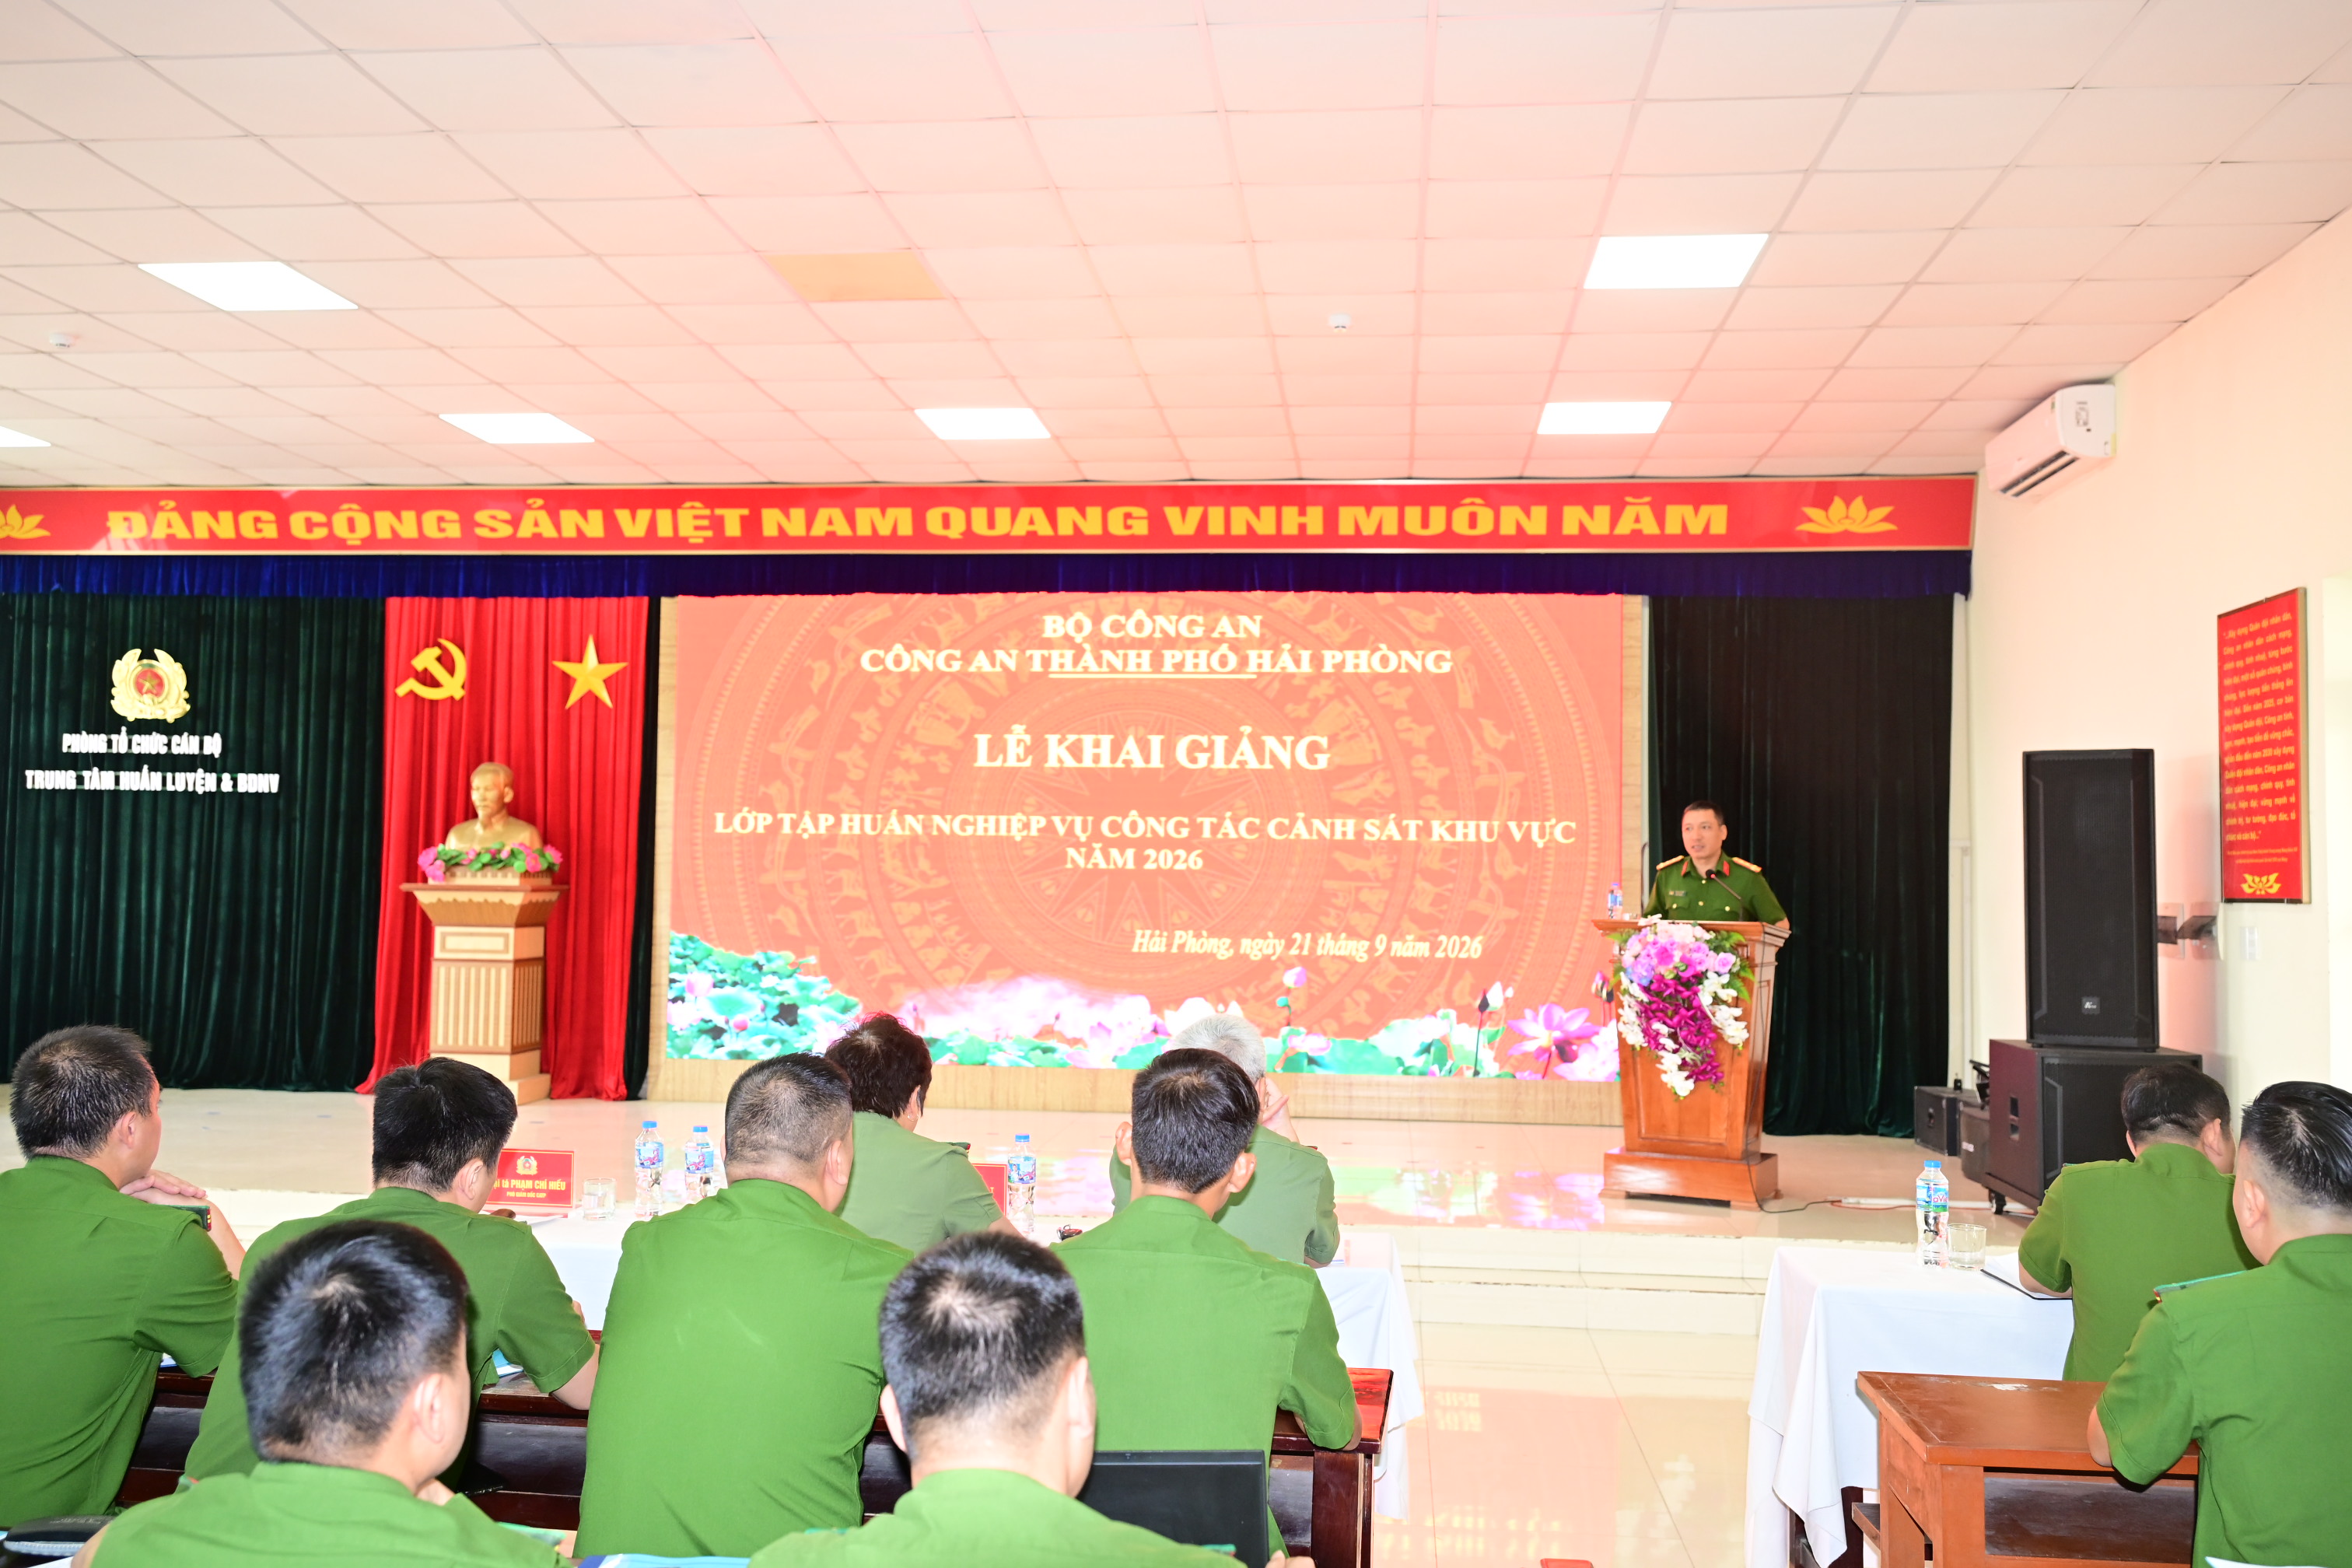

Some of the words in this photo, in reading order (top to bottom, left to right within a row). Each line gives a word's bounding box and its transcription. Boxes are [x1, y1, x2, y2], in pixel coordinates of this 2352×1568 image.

[107, 500, 278, 539] ĐẢNG
[290, 503, 461, 545] CỘNG
[474, 498, 604, 538] SẢN
[614, 501, 749, 543] VIỆT
[761, 507, 913, 537] NAM
[926, 506, 1149, 539] QUANG
[1164, 506, 1323, 536] VINH
[1338, 497, 1548, 536] MUÔN
[1562, 495, 1728, 536] NĂM
[1041, 611, 1093, 643] BỘ
[1101, 608, 1206, 639] CÔNG
[1211, 614, 1263, 638] AN
[2266, 633, 2277, 642] cách
[859, 643, 963, 672] CÔNG
[968, 649, 1020, 672] AN
[1025, 642, 1153, 672] THÀNH
[1160, 643, 1237, 673] PHỐ
[1245, 643, 1313, 673] HẢI
[1321, 643, 1454, 674] PHÒNG
[2264, 716, 2277, 725] Công
[2284, 711, 2294, 720] tinh,
[62, 730, 107, 754] PHÒNG
[111, 726, 129, 754] TỔ
[131, 731, 168, 755] CHỨC
[171, 731, 200, 754] CÁN
[203, 732, 222, 758] BỘ
[973, 724, 1033, 767] LỄ
[1044, 733, 1165, 768] KHAI
[1175, 725, 1331, 771] GIẢNG
[2282, 746, 2294, 754] dựng
[25, 769, 76, 789] TRUNG
[82, 767, 115, 790] TÂM
[119, 764, 163, 791] HUẤN
[166, 768, 217, 795] LUYỆN
[220, 772, 233, 793] &
[237, 773, 280, 793] BDNV
[2264, 765, 2277, 774] Công
[2283, 761, 2295, 770] nhân
[2286, 778, 2295, 786] tinh
[714, 807, 773, 834] LỚP
[777, 810, 835, 839] TẬP
[840, 809, 924, 835] HUẤN
[931, 812, 1047, 842] NGHIỆP
[1051, 815, 1094, 842] VỤ
[1100, 810, 1190, 838] CÔNG
[1197, 811, 1260, 840] TÁC
[1267, 811, 1356, 840] CẢNH
[1363, 813, 1423, 842] SÁT
[1430, 820, 1500, 843] KHU
[1507, 817, 1576, 848] VỰC
[1064, 842, 1136, 870] NĂM
[1143, 848, 1203, 870] 2026
[1132, 929, 1168, 953] Hải
[1171, 929, 1234, 960] Phòng,
[1239, 931, 1285, 961] ngày
[1289, 932, 1312, 956] 21
[1316, 933, 1370, 963] tháng
[1374, 933, 1388, 957] 9
[1390, 934, 1430, 958] năm
[1434, 935, 1483, 959] 2026
[502, 1179, 509, 1188] tá
[511, 1179, 533, 1191] PHẠM
[534, 1179, 547, 1189] CHÍ
[548, 1179, 565, 1190] HIẾU
